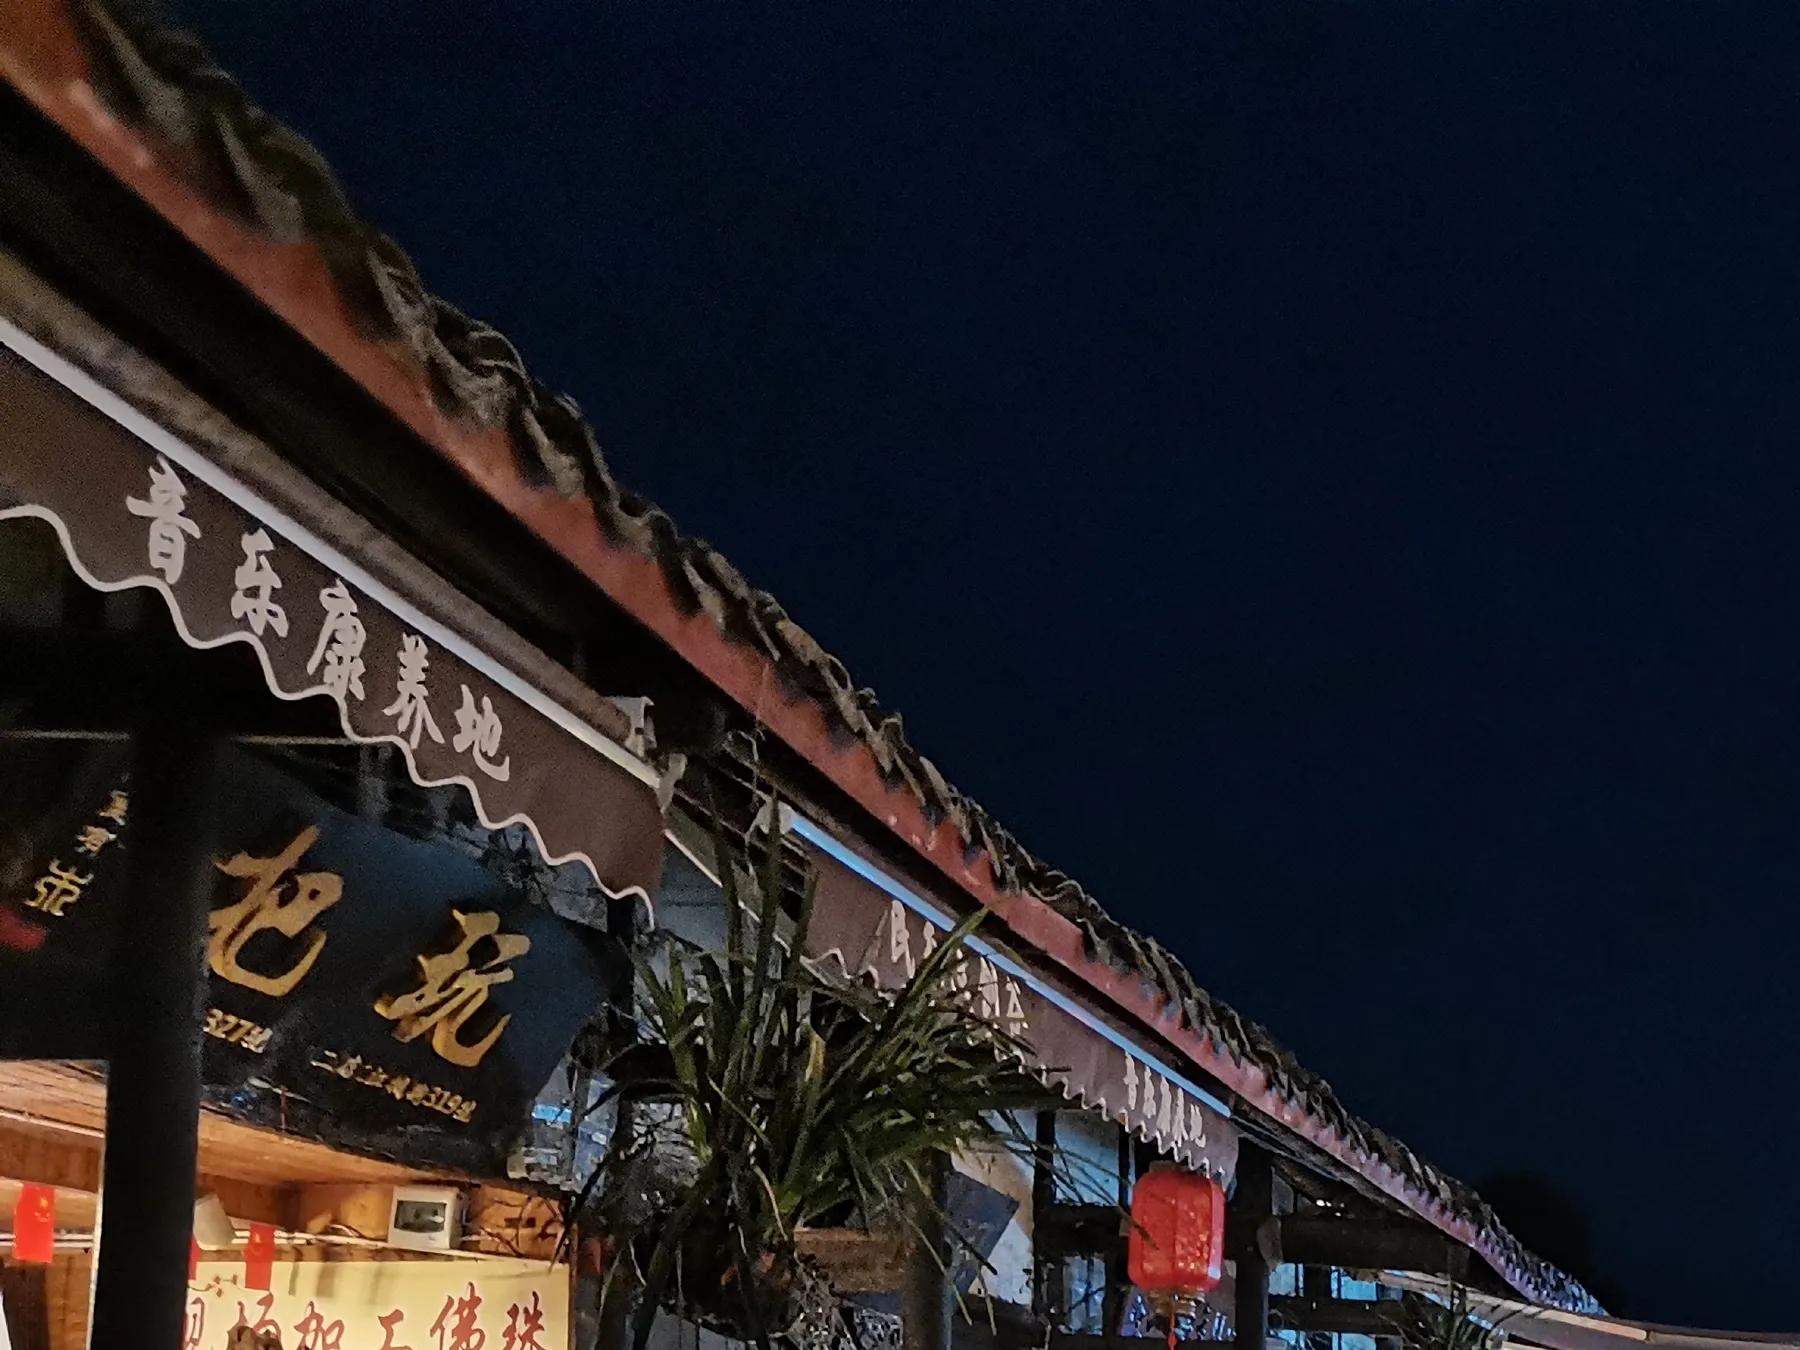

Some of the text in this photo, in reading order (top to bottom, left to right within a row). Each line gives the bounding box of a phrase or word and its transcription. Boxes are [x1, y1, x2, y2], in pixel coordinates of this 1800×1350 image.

[126, 454, 510, 782] 音乐康养地
